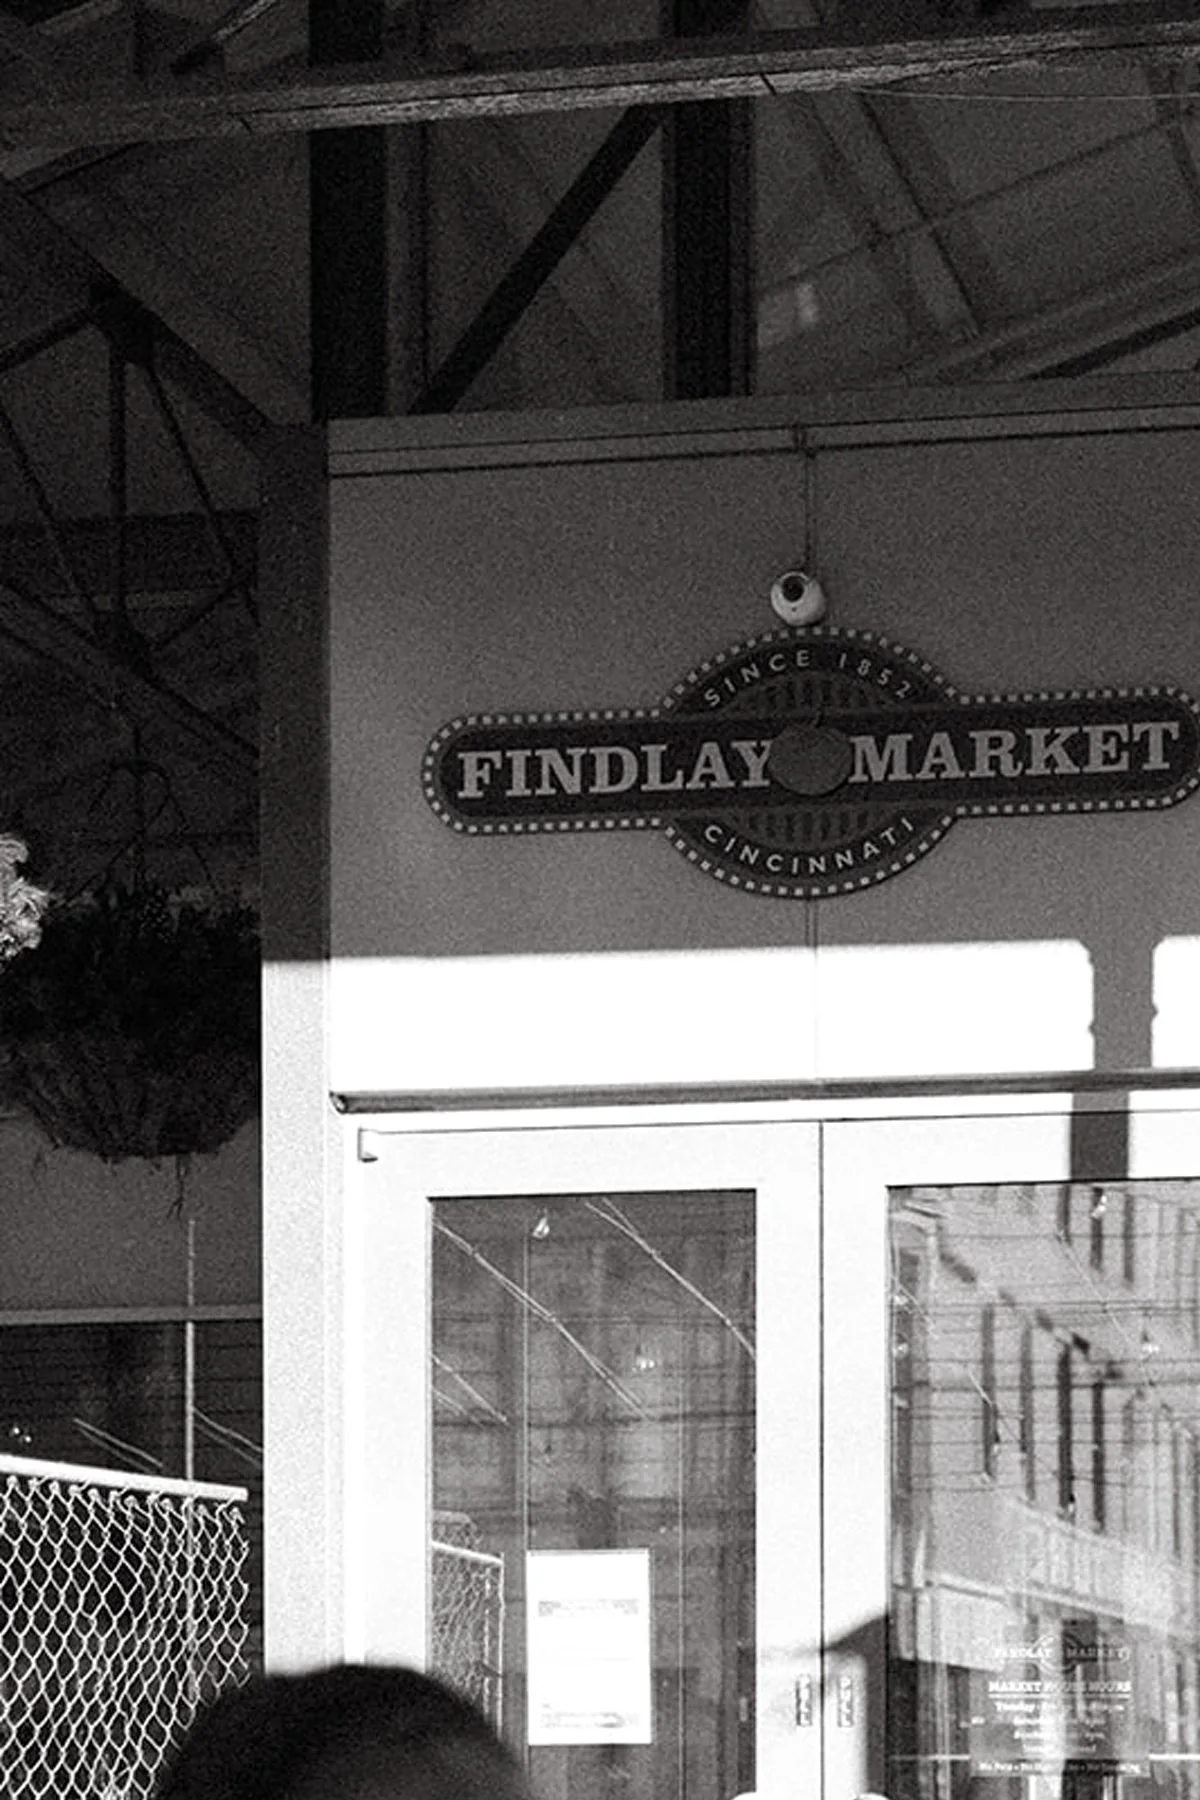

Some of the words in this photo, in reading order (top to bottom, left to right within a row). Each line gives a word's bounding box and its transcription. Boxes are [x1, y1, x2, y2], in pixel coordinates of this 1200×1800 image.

[705, 650, 811, 707] SINCE
[838, 653, 912, 698] 1852
[457, 740, 772, 798] FINDLAY
[848, 721, 1181, 783] MARKET
[705, 816, 914, 875] CINCINNATI
